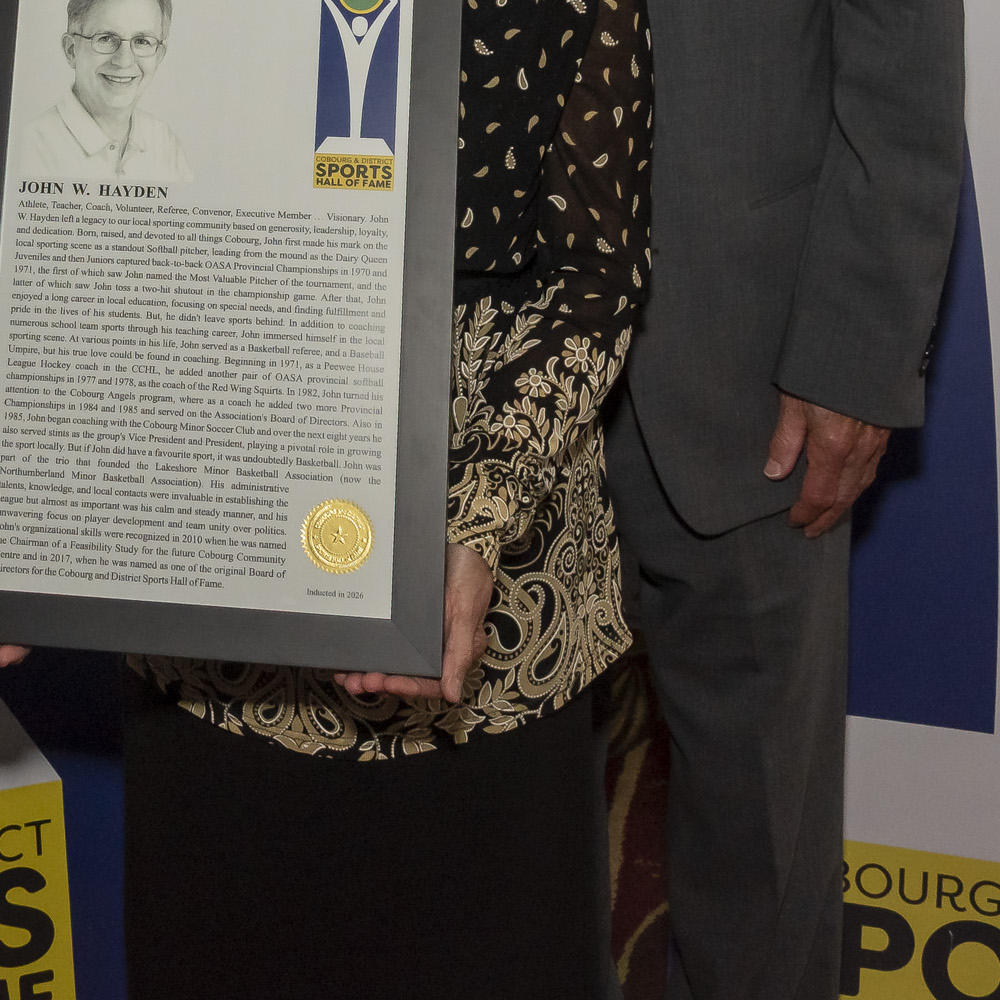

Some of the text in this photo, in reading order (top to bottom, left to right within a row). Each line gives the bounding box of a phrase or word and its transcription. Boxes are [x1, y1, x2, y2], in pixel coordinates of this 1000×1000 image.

[315, 163, 393, 179] SPORTS
[316, 156, 352, 164] COBOURG
[18, 181, 168, 198] JOHN W. HAYDEN
[316, 178, 391, 188] HALL OF FAME
[18, 199, 389, 224] Athlete, Teacher, Coach, Volunteer, Referee, Convenor, Executive Member Visionary. John
[14, 251, 387, 276] Juveniles and then Juniors captured back-to-back OASA Provincial Championships in 1970 and
[15, 238, 34, 246] local
[36, 239, 68, 250] sporting
[111, 243, 144, 252] standout
[146, 244, 177, 253] Softball
[179, 246, 209, 257] pitcher,
[211, 247, 241, 258] leading
[243, 249, 262, 257] from
[264, 250, 277, 258] the
[279, 250, 307, 259] mound
[320, 252, 333, 260] the
[335, 253, 358, 264] Dairy
[360, 254, 387, 263] Queen
[7, 358, 383, 386] League Hockey coach in the CCHL, he added another pair of OASA provincial softball
[5, 384, 39, 394] attention
[42, 386, 50, 395] to
[54, 387, 66, 395] the
[69, 388, 105, 400] Cobourg
[107, 390, 136, 402] Angels
[139, 394, 175, 404] program,
[179, 394, 203, 403] where
[227, 397, 251, 406] coach
[255, 399, 265, 407] he
[268, 399, 293, 409] added
[296, 401, 312, 410] two
[341, 404, 383, 414] Provincial
[0, 452, 16, 463] part
[21, 454, 32, 462] of
[36, 454, 49, 463] the
[55, 456, 70, 464] trio
[75, 457, 91, 466] that
[97, 458, 130, 468] founded
[136, 461, 148, 469] the
[155, 462, 197, 472] Lakeshore
[203, 465, 229, 475] Minor
[235, 467, 278, 478] Basketball
[284, 470, 333, 481] Association
[368, 475, 381, 484] the
[0, 466, 65, 478] Northumberland
[71, 471, 96, 480] Minor
[102, 473, 144, 483] Basketball
[210, 479, 224, 488] His
[230, 481, 289, 492] administrative
[28, 482, 75, 495] knowledge,
[76, 485, 91, 494] and
[93, 486, 112, 495] local
[114, 487, 147, 497] contacts
[149, 491, 169, 499] were
[171, 491, 213, 502] invaluable
[215, 494, 223, 502] in
[225, 495, 274, 508] establishing
[276, 498, 288, 507] the
[46, 511, 68, 520] focus
[84, 513, 110, 525] player
[112, 515, 165, 529] development
[167, 519, 183, 528] and
[185, 520, 206, 529] team
[208, 521, 230, 533] unity
[254, 525, 286, 537] politics.
[9, 536, 49, 547] Chairman
[51, 539, 61, 548] of
[70, 540, 112, 553] Feasibility
[114, 543, 138, 555] Study
[141, 545, 153, 554] for
[155, 546, 168, 555] the
[171, 547, 195, 557] future
[197, 549, 234, 562] Cobourg
[236, 552, 286, 566] Community
[31, 566, 44, 575] for
[44, 567, 57, 576] the
[57, 568, 93, 581] Cobourg
[94, 570, 109, 579] and
[110, 571, 141, 582] District
[142, 574, 168, 586] Sports
[170, 576, 187, 585] Hall
[188, 577, 199, 586] of
[199, 578, 224, 588] Fame.
[306, 588, 337, 598] Inducted
[346, 591, 364, 599] 2026
[843, 860, 1000, 917] OURG
